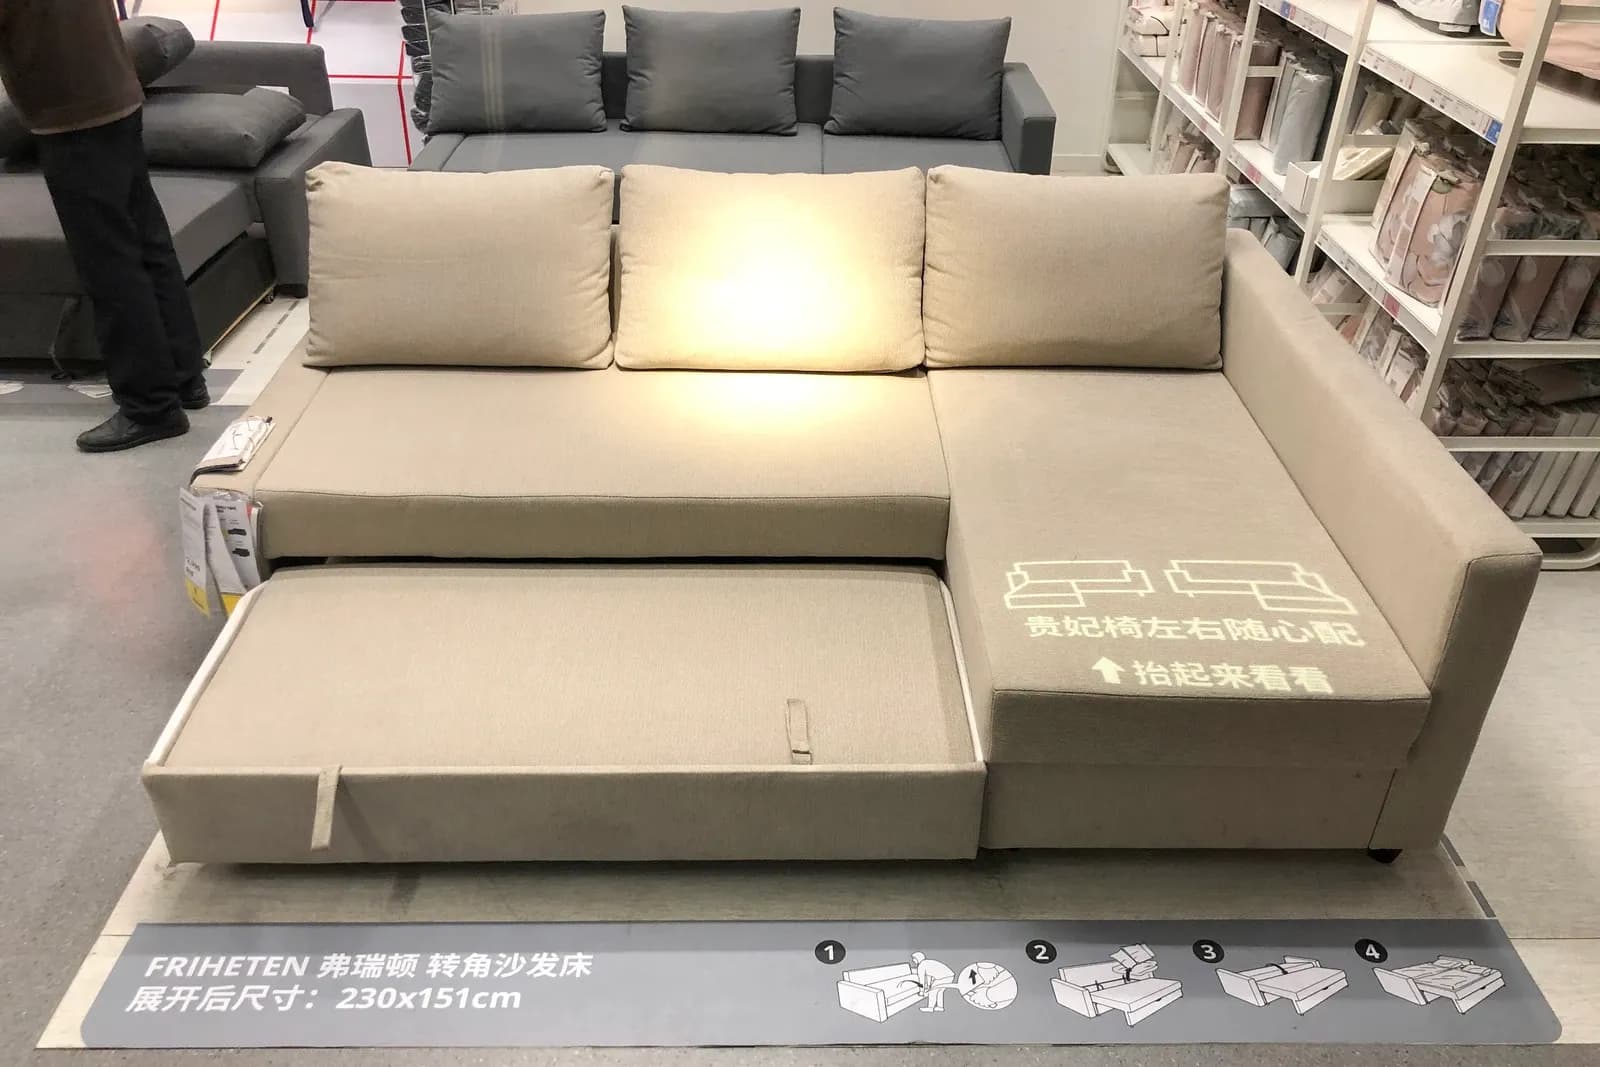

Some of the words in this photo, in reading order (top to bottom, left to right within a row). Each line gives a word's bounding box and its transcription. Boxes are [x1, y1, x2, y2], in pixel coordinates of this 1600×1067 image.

[1024, 615, 1366, 648] 贵妃椅左右随心配
[1131, 660, 1335, 695] 抬起来看看
[823, 945, 835, 961] 1
[1033, 944, 1050, 960] 2
[1200, 944, 1217, 960] 3
[1365, 943, 1381, 959] 4
[144, 956, 310, 977] FRIHETEN
[317, 953, 420, 979] 弗瑞顿
[426, 952, 594, 979] 转角沙发床
[335, 987, 521, 1010] 230x151cm
